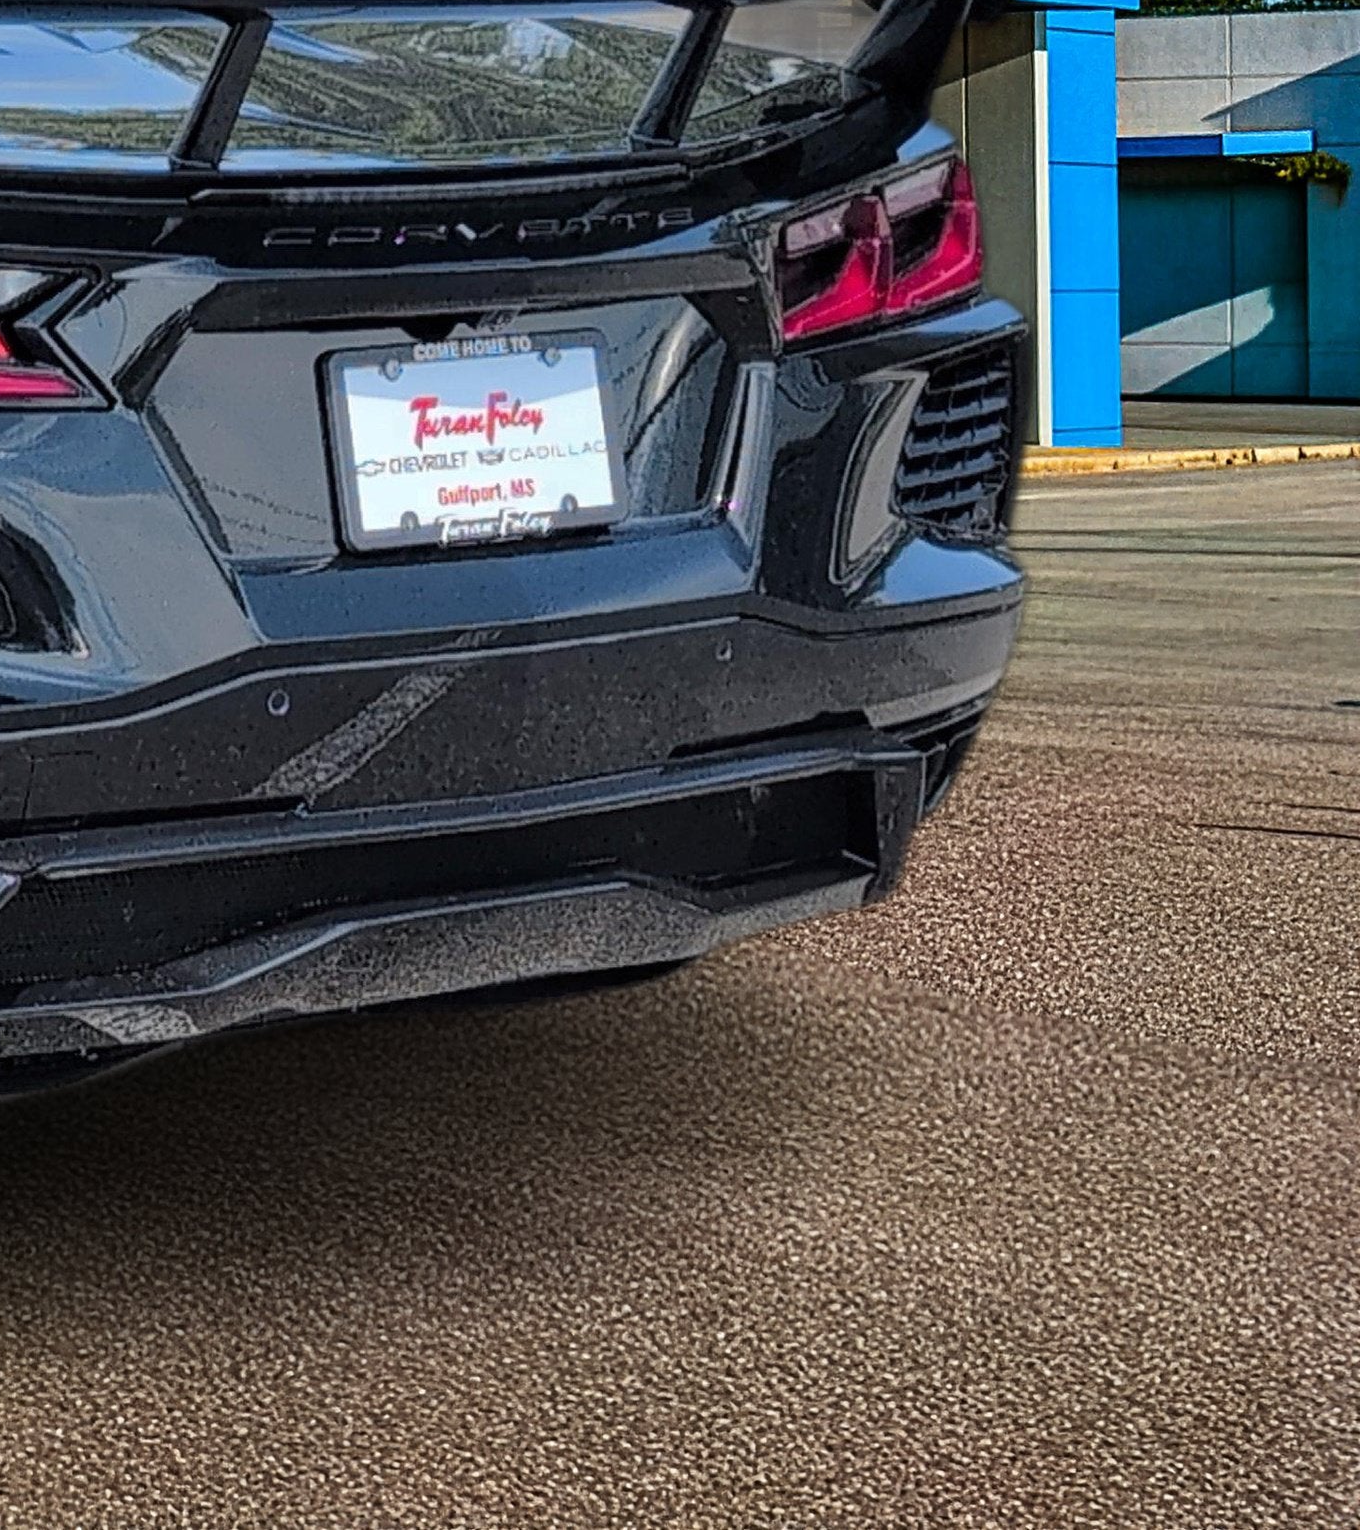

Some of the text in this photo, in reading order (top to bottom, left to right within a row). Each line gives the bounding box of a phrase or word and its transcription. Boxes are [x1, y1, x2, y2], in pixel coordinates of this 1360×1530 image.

[509, 334, 531, 353] TO
[389, 440, 606, 474] CHEVROLET CADILLAC
[510, 479, 536, 498] MS
